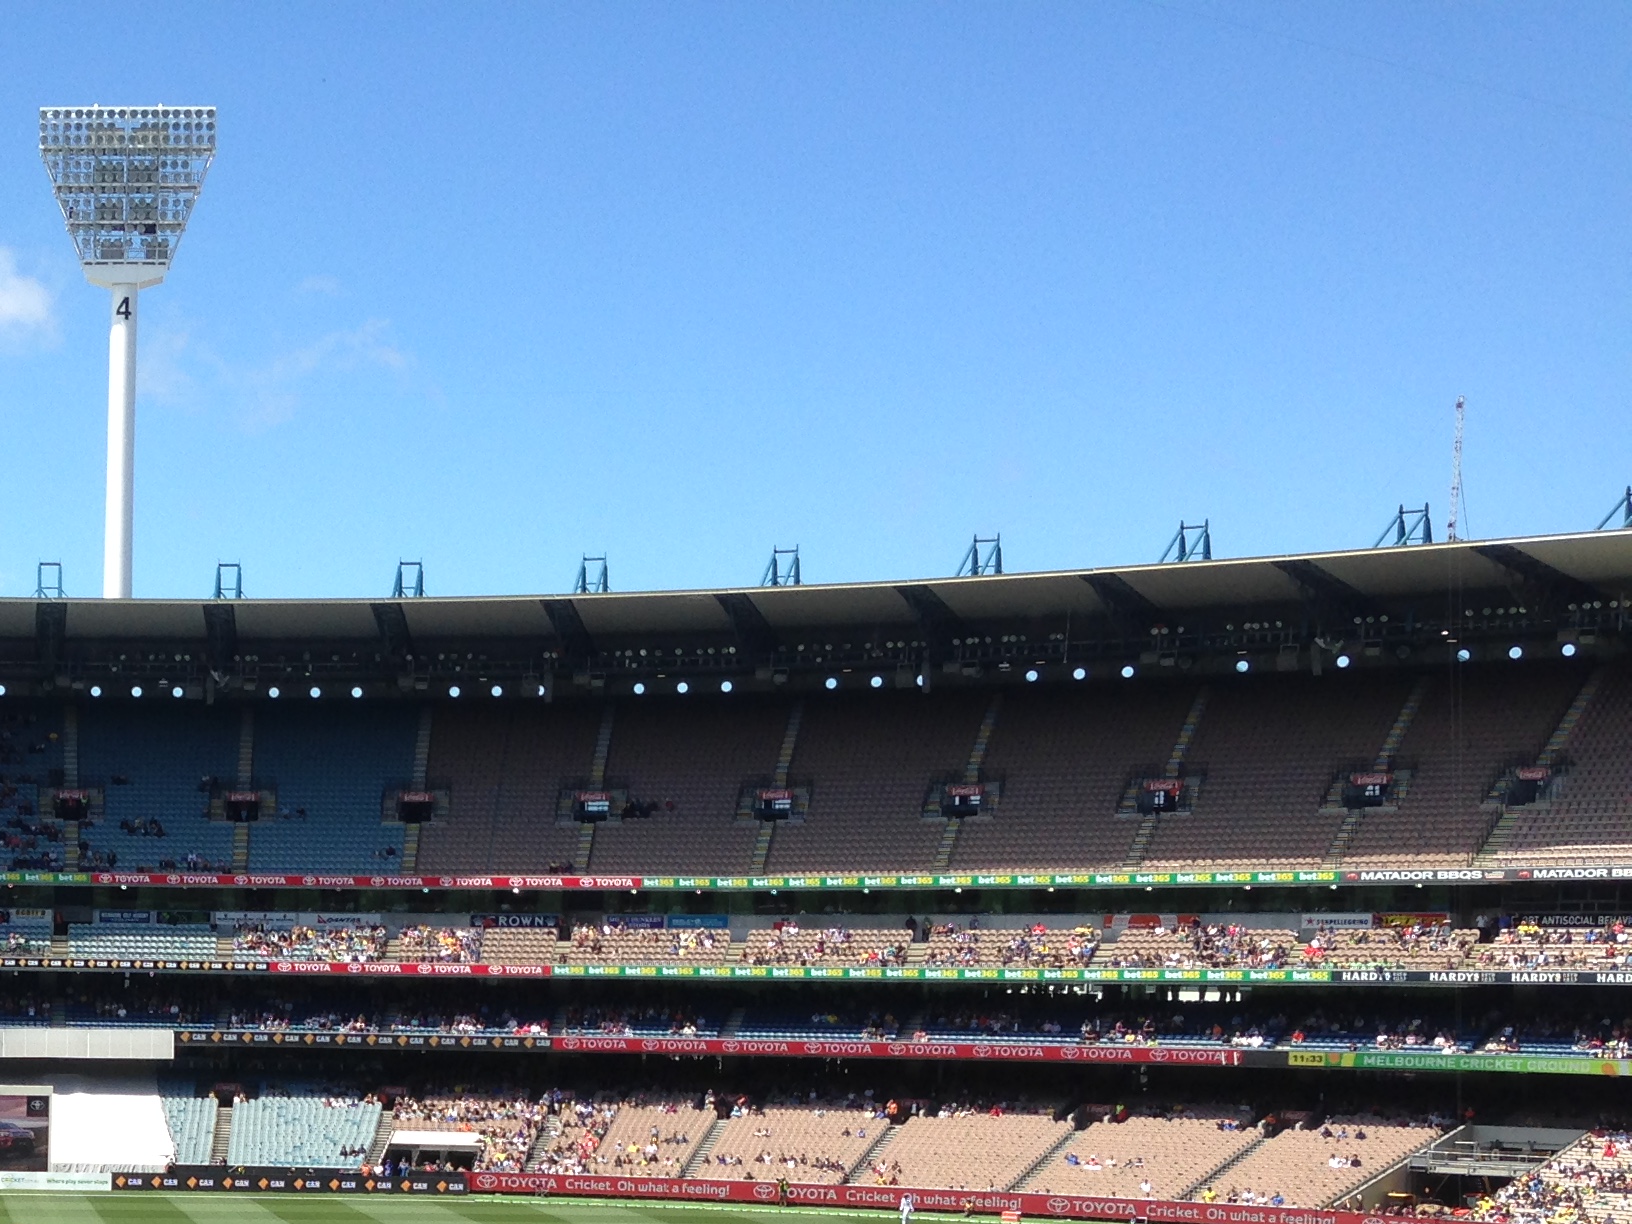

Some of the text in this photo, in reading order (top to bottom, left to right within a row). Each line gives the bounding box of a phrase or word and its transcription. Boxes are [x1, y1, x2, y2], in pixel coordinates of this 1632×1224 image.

[116, 297, 132, 320] 4
[1361, 872, 1433, 880] MATADOR
[1534, 869, 1608, 877] MATADOR
[596, 878, 633, 886] TOYOTA
[1542, 916, 1595, 925] ANTISOCIAL
[434, 965, 471, 973] TOYOTA
[581, 1040, 626, 1048] TOYOTA
[661, 1041, 706, 1049] TOYOTA
[824, 1044, 871, 1053] TOYOTA
[908, 1045, 956, 1054] TOYOTA
[994, 1047, 1043, 1056] TOYOTA
[1082, 1049, 1131, 1058] TOYOTA
[1171, 1051, 1222, 1060] TOYOTA
[1363, 1055, 1590, 1072] MELBOURNE CRICKET GROUND
[500, 1177, 557, 1187] TOYOTA
[566, 1179, 729, 1197] Cricket. Oh what a feeling!
[781, 1188, 837, 1200] OYOTA
[924, 1194, 956, 1206] what
[1073, 1201, 1136, 1214] TOYOTA
[1146, 1205, 1202, 1218] Cricket.
[1207, 1208, 1226, 1219] Oh
[1230, 1212, 1265, 1222] what
[1268, 1215, 1276, 1223] a
